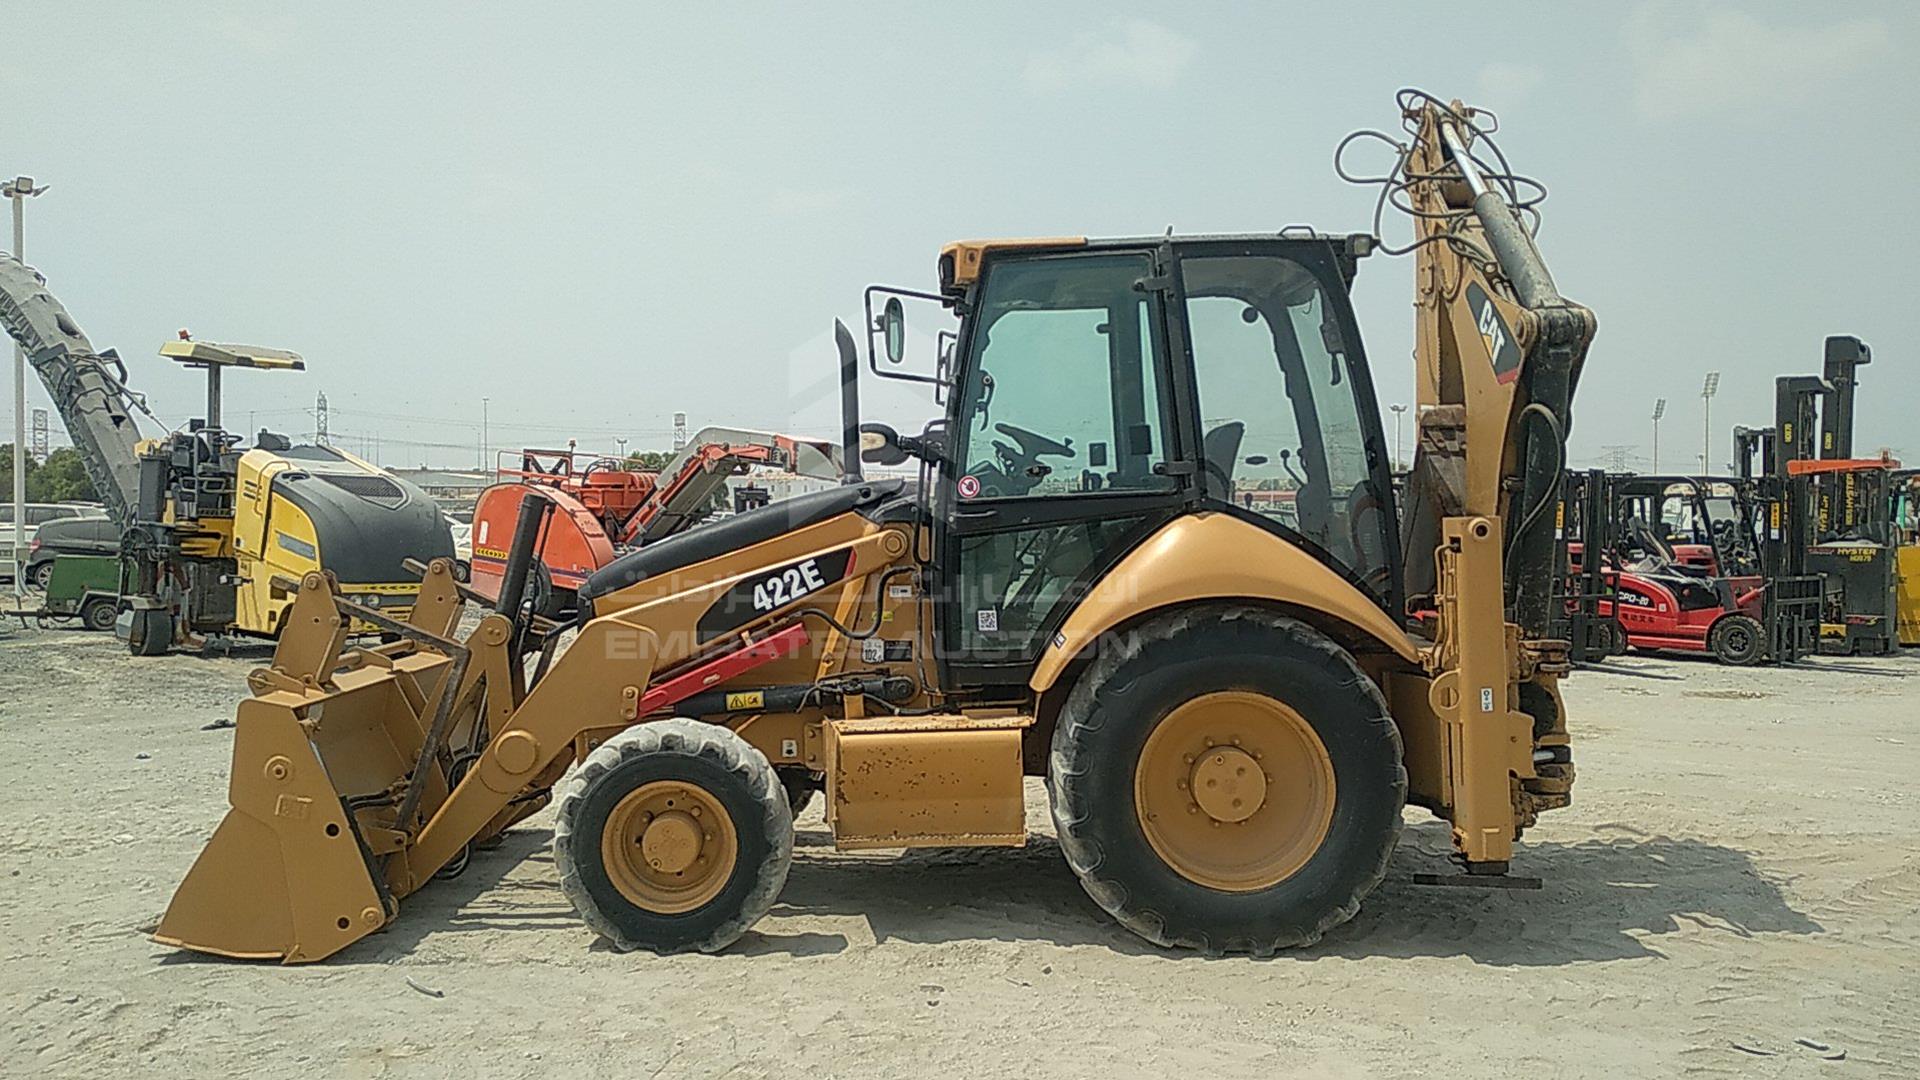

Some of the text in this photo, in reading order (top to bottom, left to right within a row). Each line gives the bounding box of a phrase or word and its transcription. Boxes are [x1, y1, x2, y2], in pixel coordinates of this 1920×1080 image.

[1479, 299, 1506, 366] CAT
[1837, 548, 1877, 556] HYSTER
[753, 558, 826, 612] 422E
